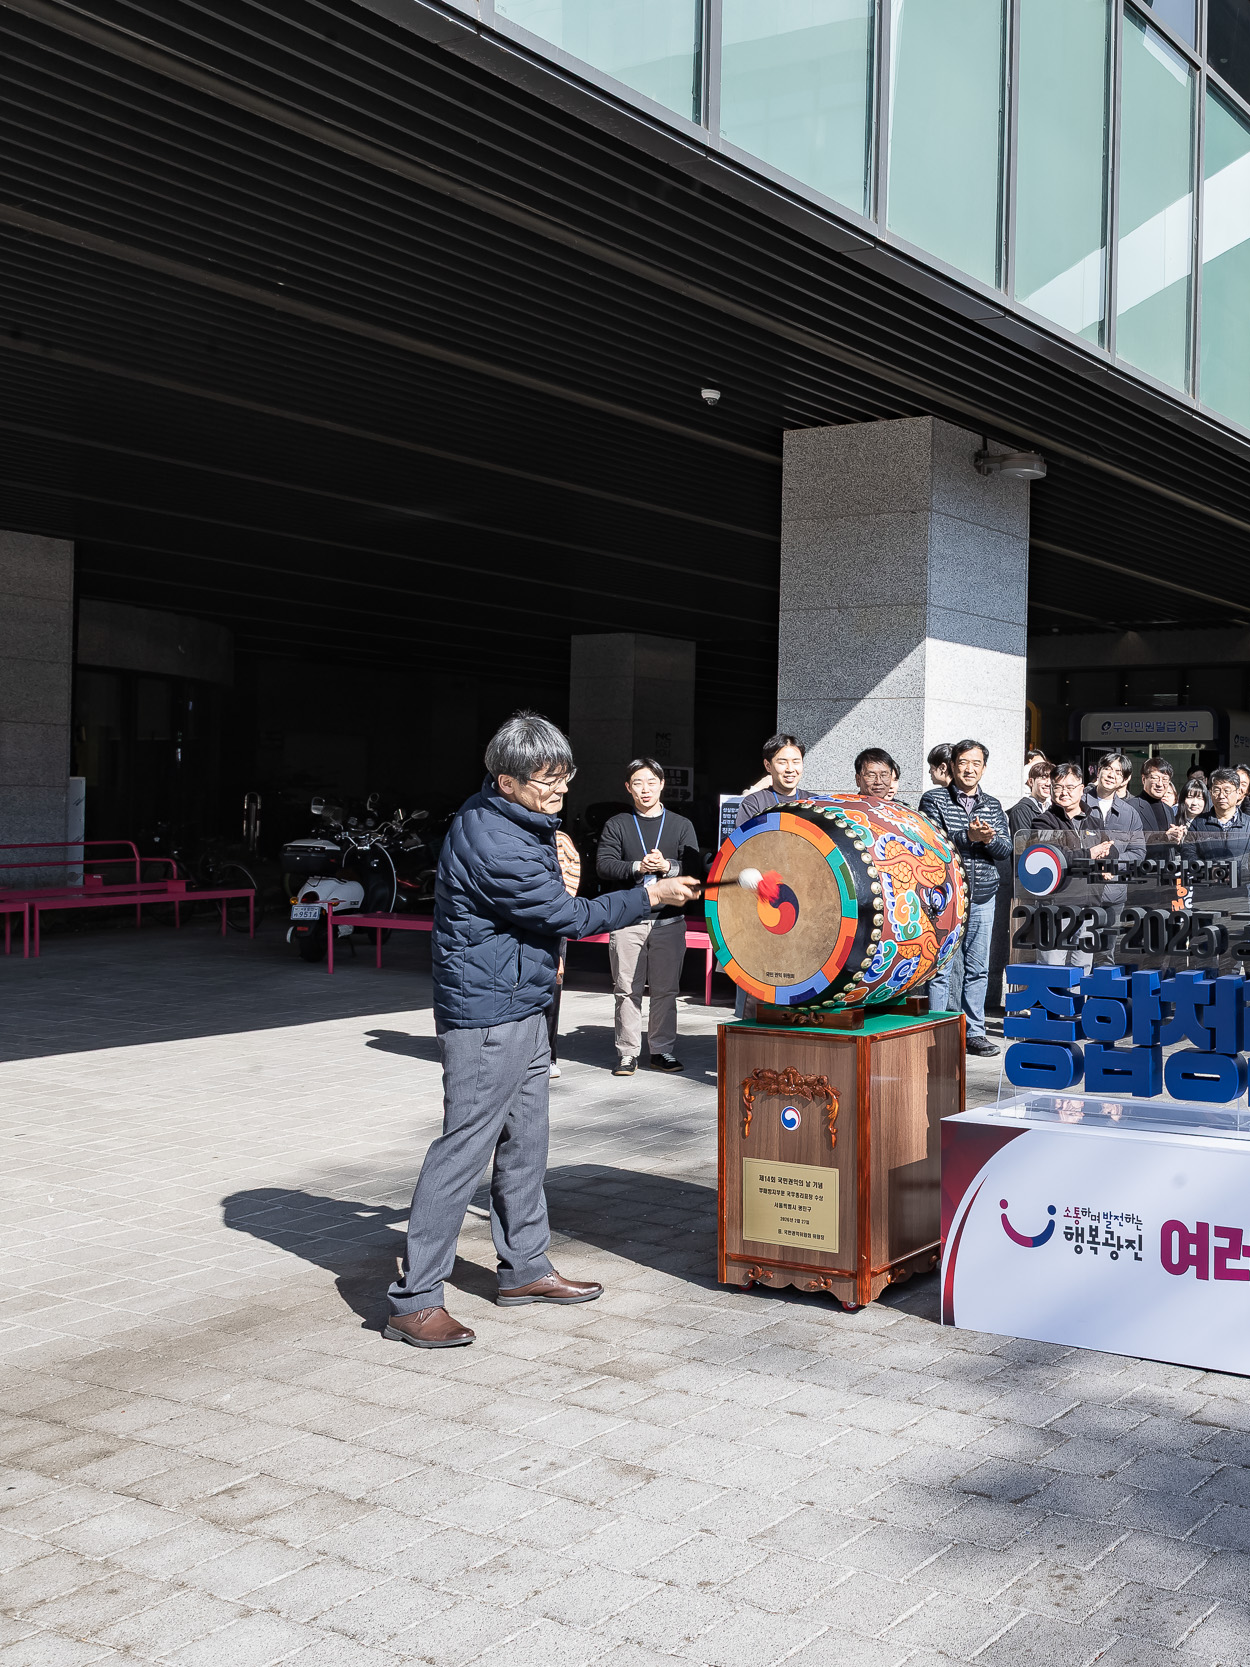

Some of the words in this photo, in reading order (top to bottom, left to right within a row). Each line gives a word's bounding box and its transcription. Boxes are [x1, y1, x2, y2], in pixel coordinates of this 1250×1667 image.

[1113, 720, 1199, 733] 무인민원발급창구
[1062, 1206, 1101, 1226] 소통하며
[1102, 1210, 1144, 1232] 발전하는
[1062, 1224, 1143, 1262] 행복광진
